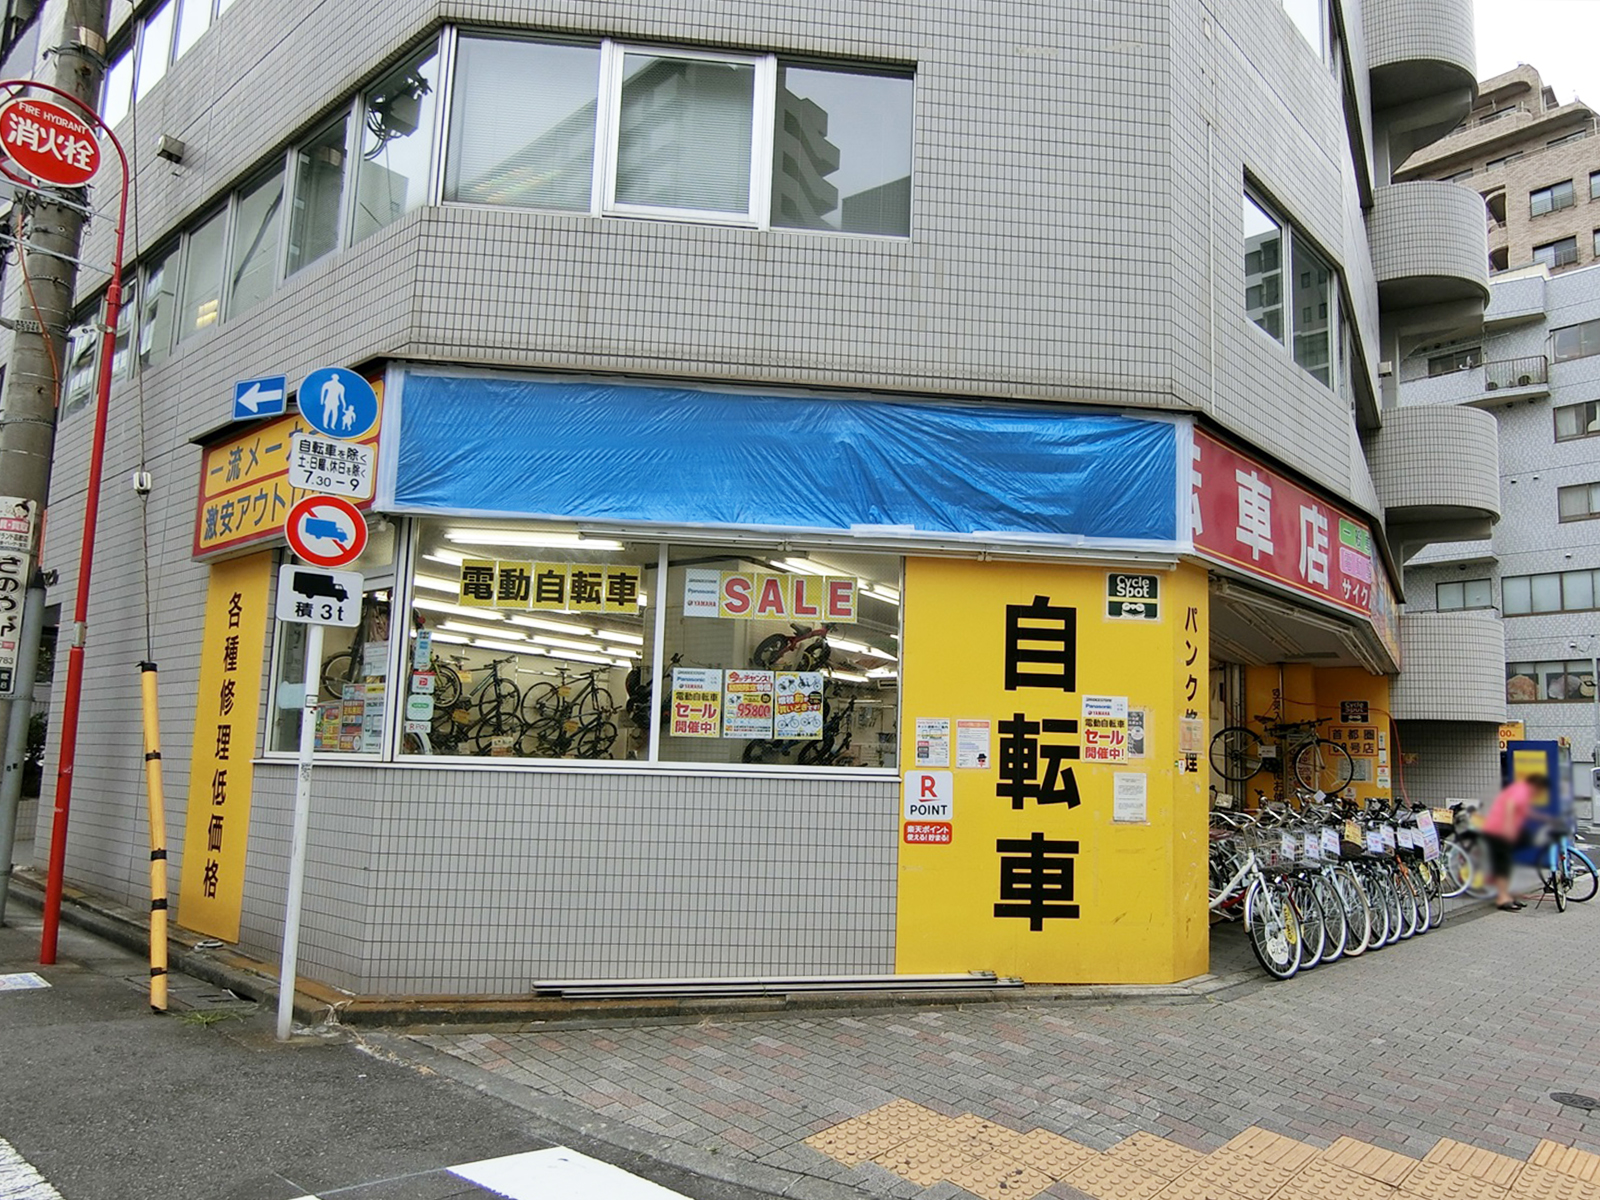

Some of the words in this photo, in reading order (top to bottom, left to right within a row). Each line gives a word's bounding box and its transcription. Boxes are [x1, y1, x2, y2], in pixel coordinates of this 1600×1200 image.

[18, 102, 41, 118] FIRE
[43, 111, 88, 135] HYDRANT
[7, 112, 96, 173] 消火栓
[299, 439, 368, 463] 自転車を除く
[463, 566, 638, 606] 電動自転車
[1116, 575, 1150, 588] Cycle
[1116, 585, 1150, 598] Spot
[724, 577, 853, 617] SALE
[1342, 578, 1371, 610] サイク
[675, 702, 718, 719] セール
[1085, 718, 1125, 728] 電動自転車
[1085, 729, 1125, 745] セール
[1333, 729, 1375, 740] 首都圏
[202, 592, 243, 899] 各種修理低価格
[993, 594, 1082, 932] 自転車
[910, 804, 947, 815] POINT
[906, 825, 949, 834] 楽天ポイント
